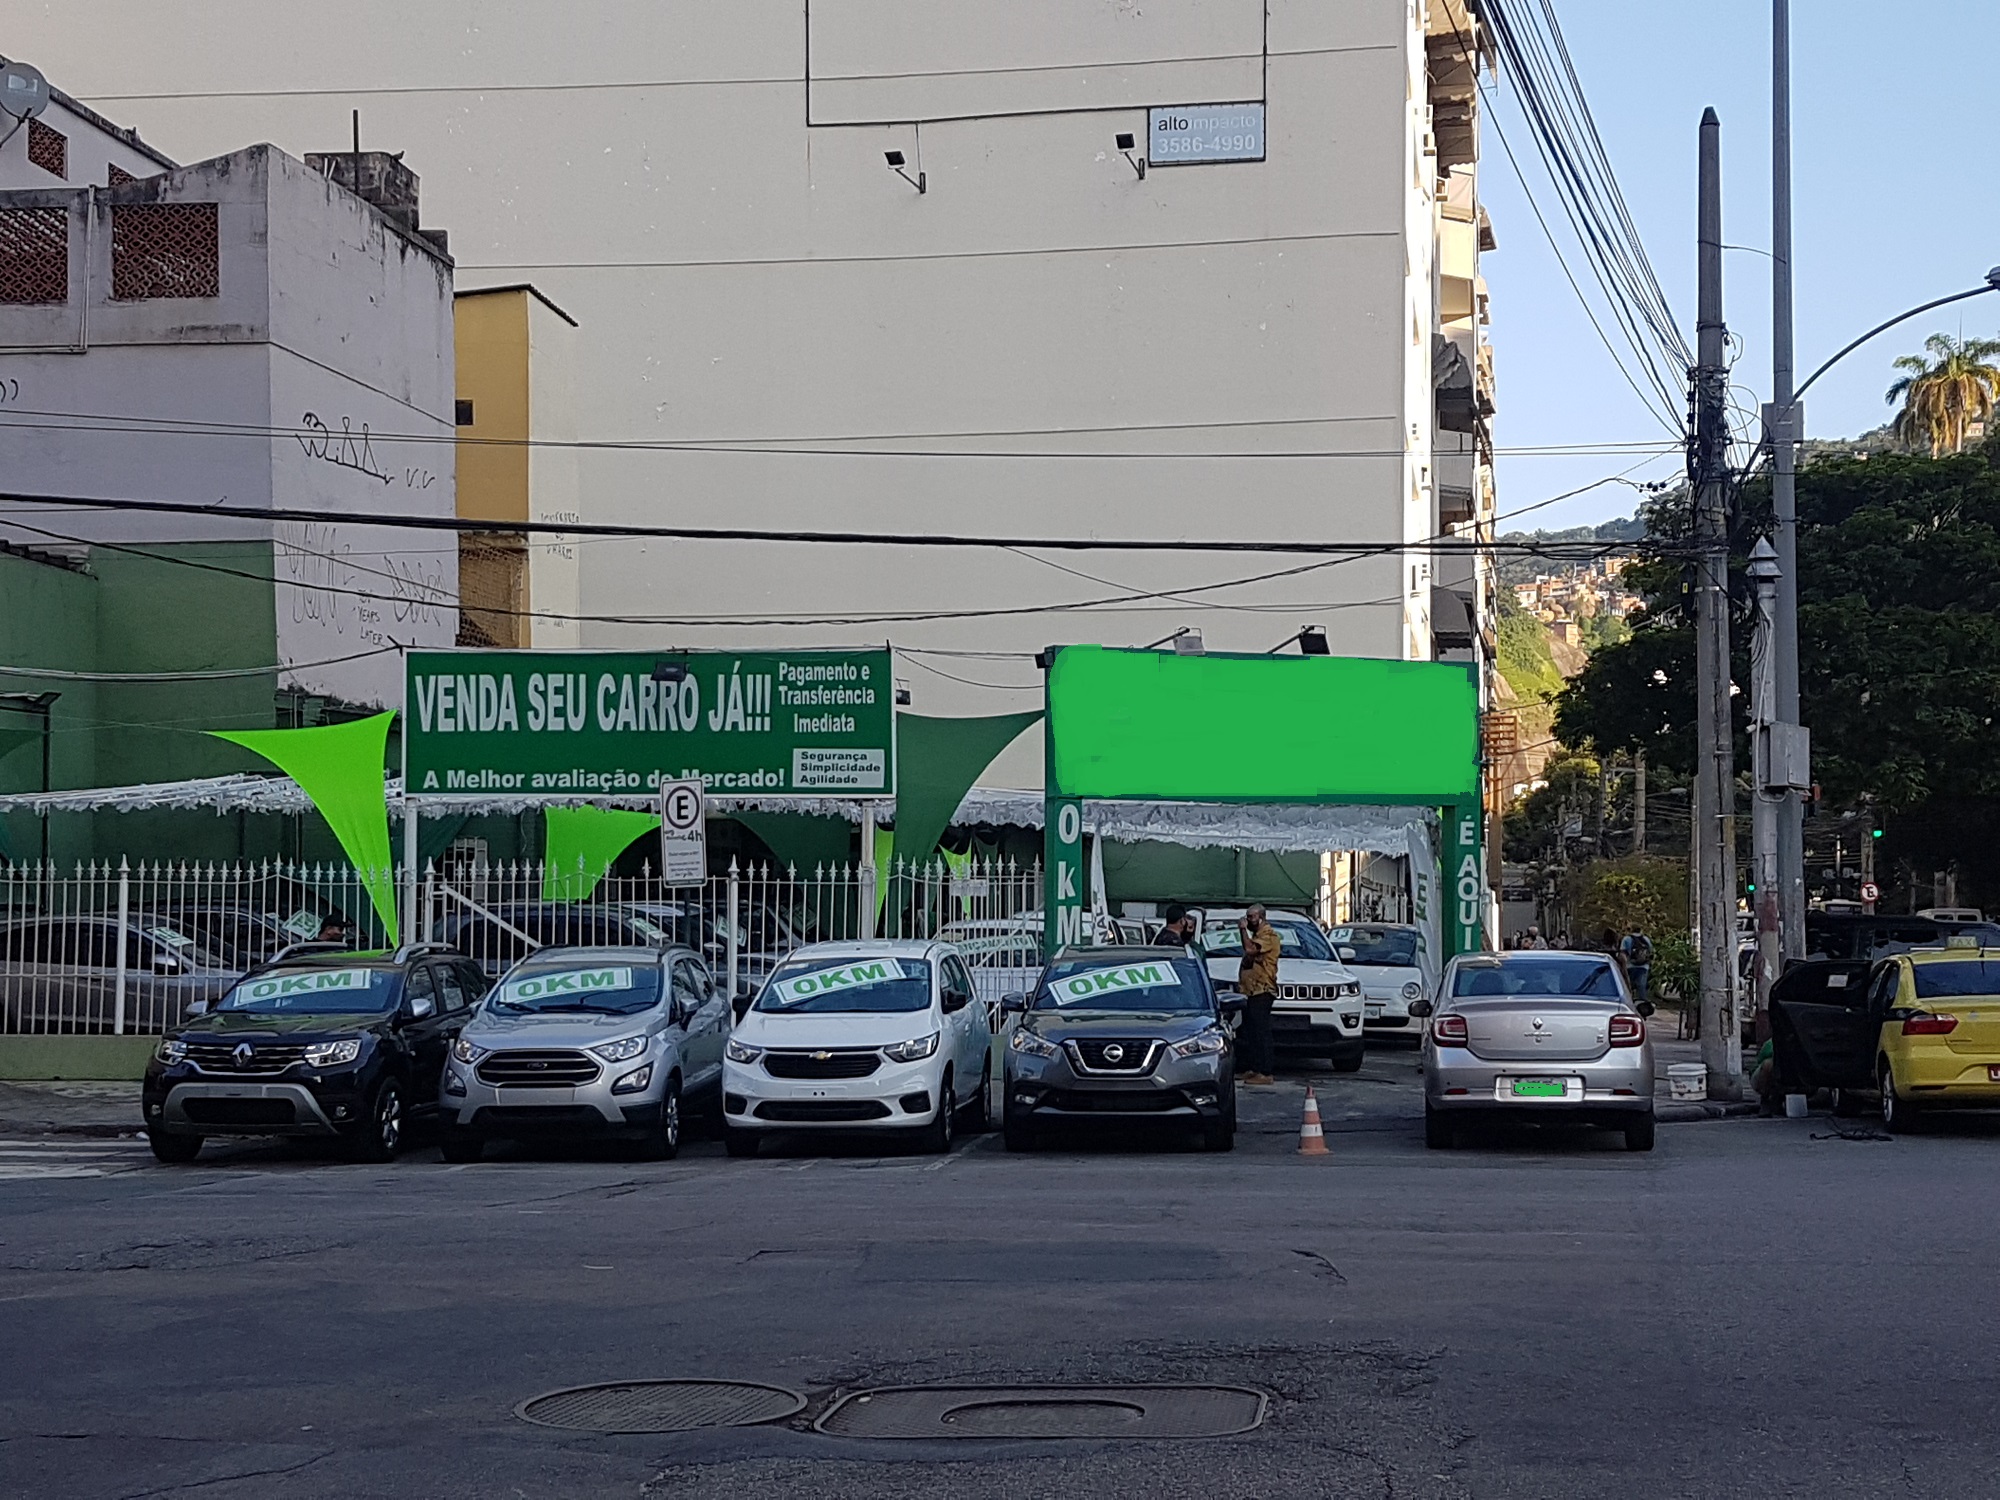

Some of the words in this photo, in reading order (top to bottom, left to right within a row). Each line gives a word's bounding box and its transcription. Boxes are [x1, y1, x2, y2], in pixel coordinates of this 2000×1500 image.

[1158, 134, 1256, 154] 3586-4990
[778, 661, 858, 687] Pagamento
[861, 664, 870, 681] e
[414, 673, 519, 732] VENDA
[527, 672, 587, 732] SEU
[597, 672, 700, 732] CARRO
[708, 660, 772, 732] JÁ!!!
[778, 684, 876, 706] Transferência
[793, 712, 856, 733] Imediata
[800, 751, 868, 762] Segurança
[800, 763, 881, 773] Simplicidade
[422, 770, 439, 789] A
[446, 769, 525, 788] Melhor
[531, 768, 641, 792] avaliação
[681, 768, 785, 787] Mercado!
[800, 775, 859, 785] Agilidade
[677, 795, 689, 820] E
[1457, 854, 1480, 950] AQUI
